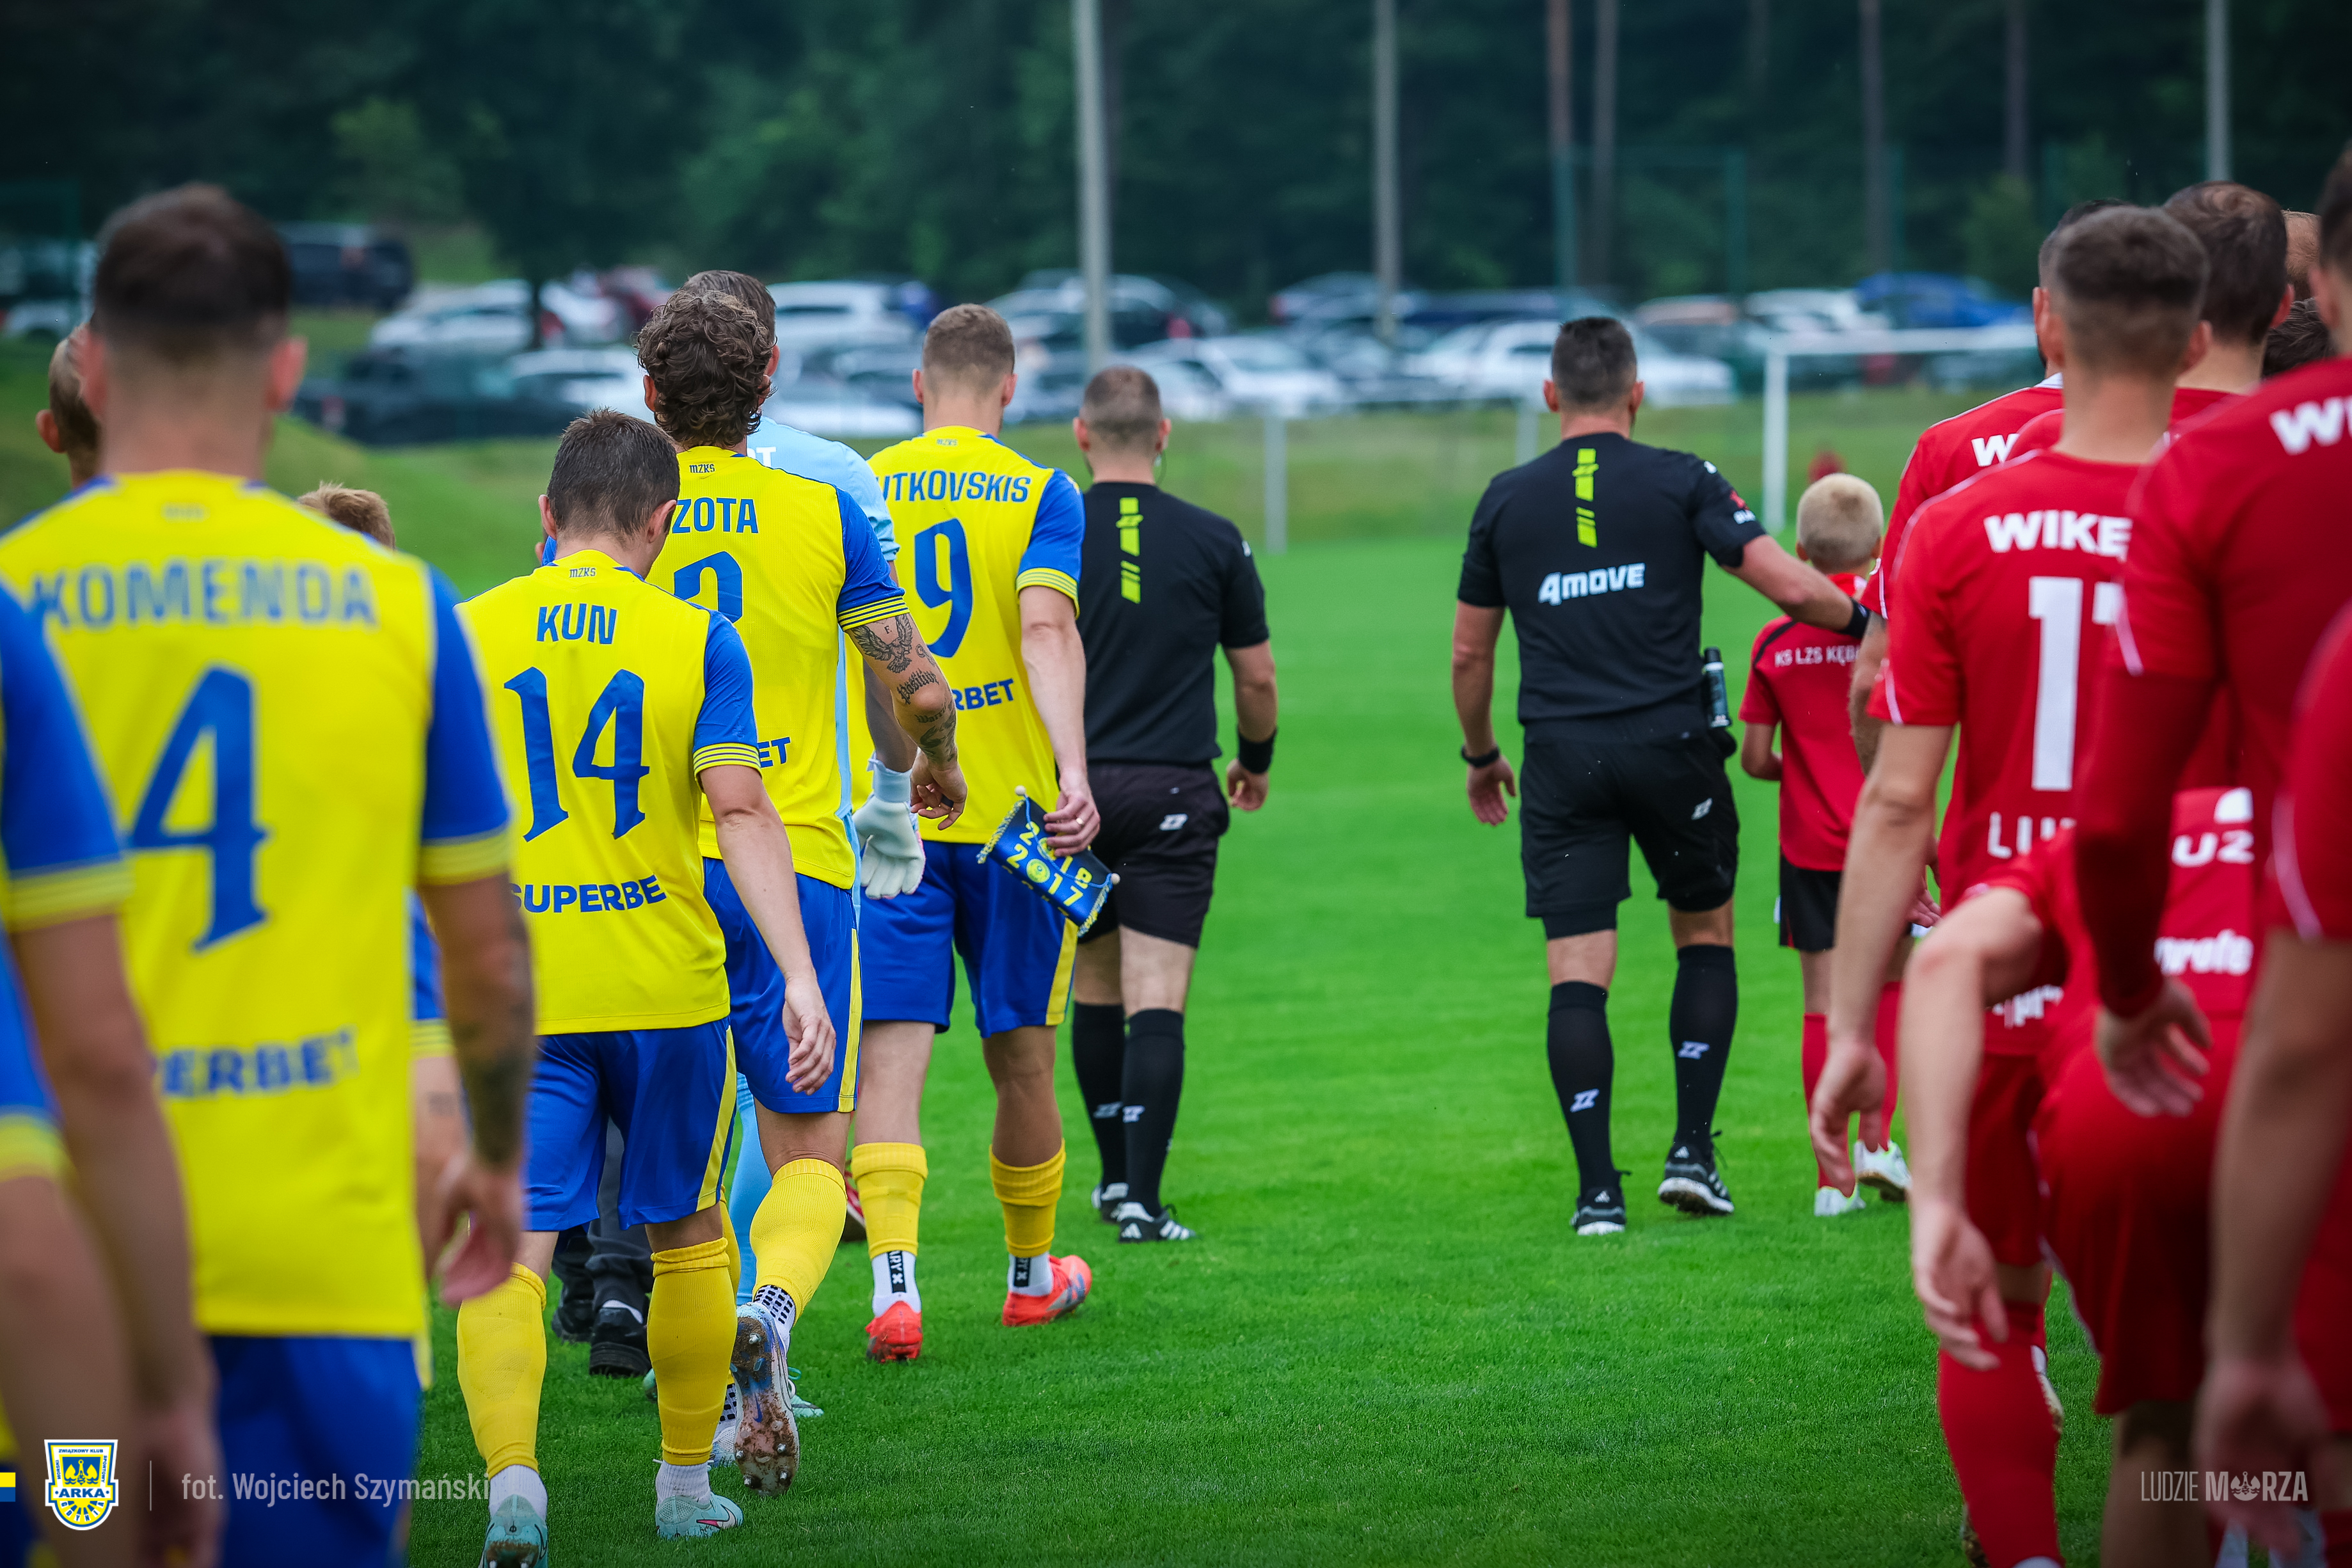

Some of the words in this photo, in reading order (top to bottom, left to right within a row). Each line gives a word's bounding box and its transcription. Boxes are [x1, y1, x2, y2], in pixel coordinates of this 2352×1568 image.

[877, 470, 1031, 502] UTKOVSKIS
[672, 497, 759, 534] ZOTA
[33, 557, 377, 632] KOMENDA
[914, 518, 973, 658] 9
[536, 603, 617, 644] KUN
[504, 666, 650, 842] 14
[131, 663, 273, 953] 4
[510, 875, 667, 913] SUPERBE
